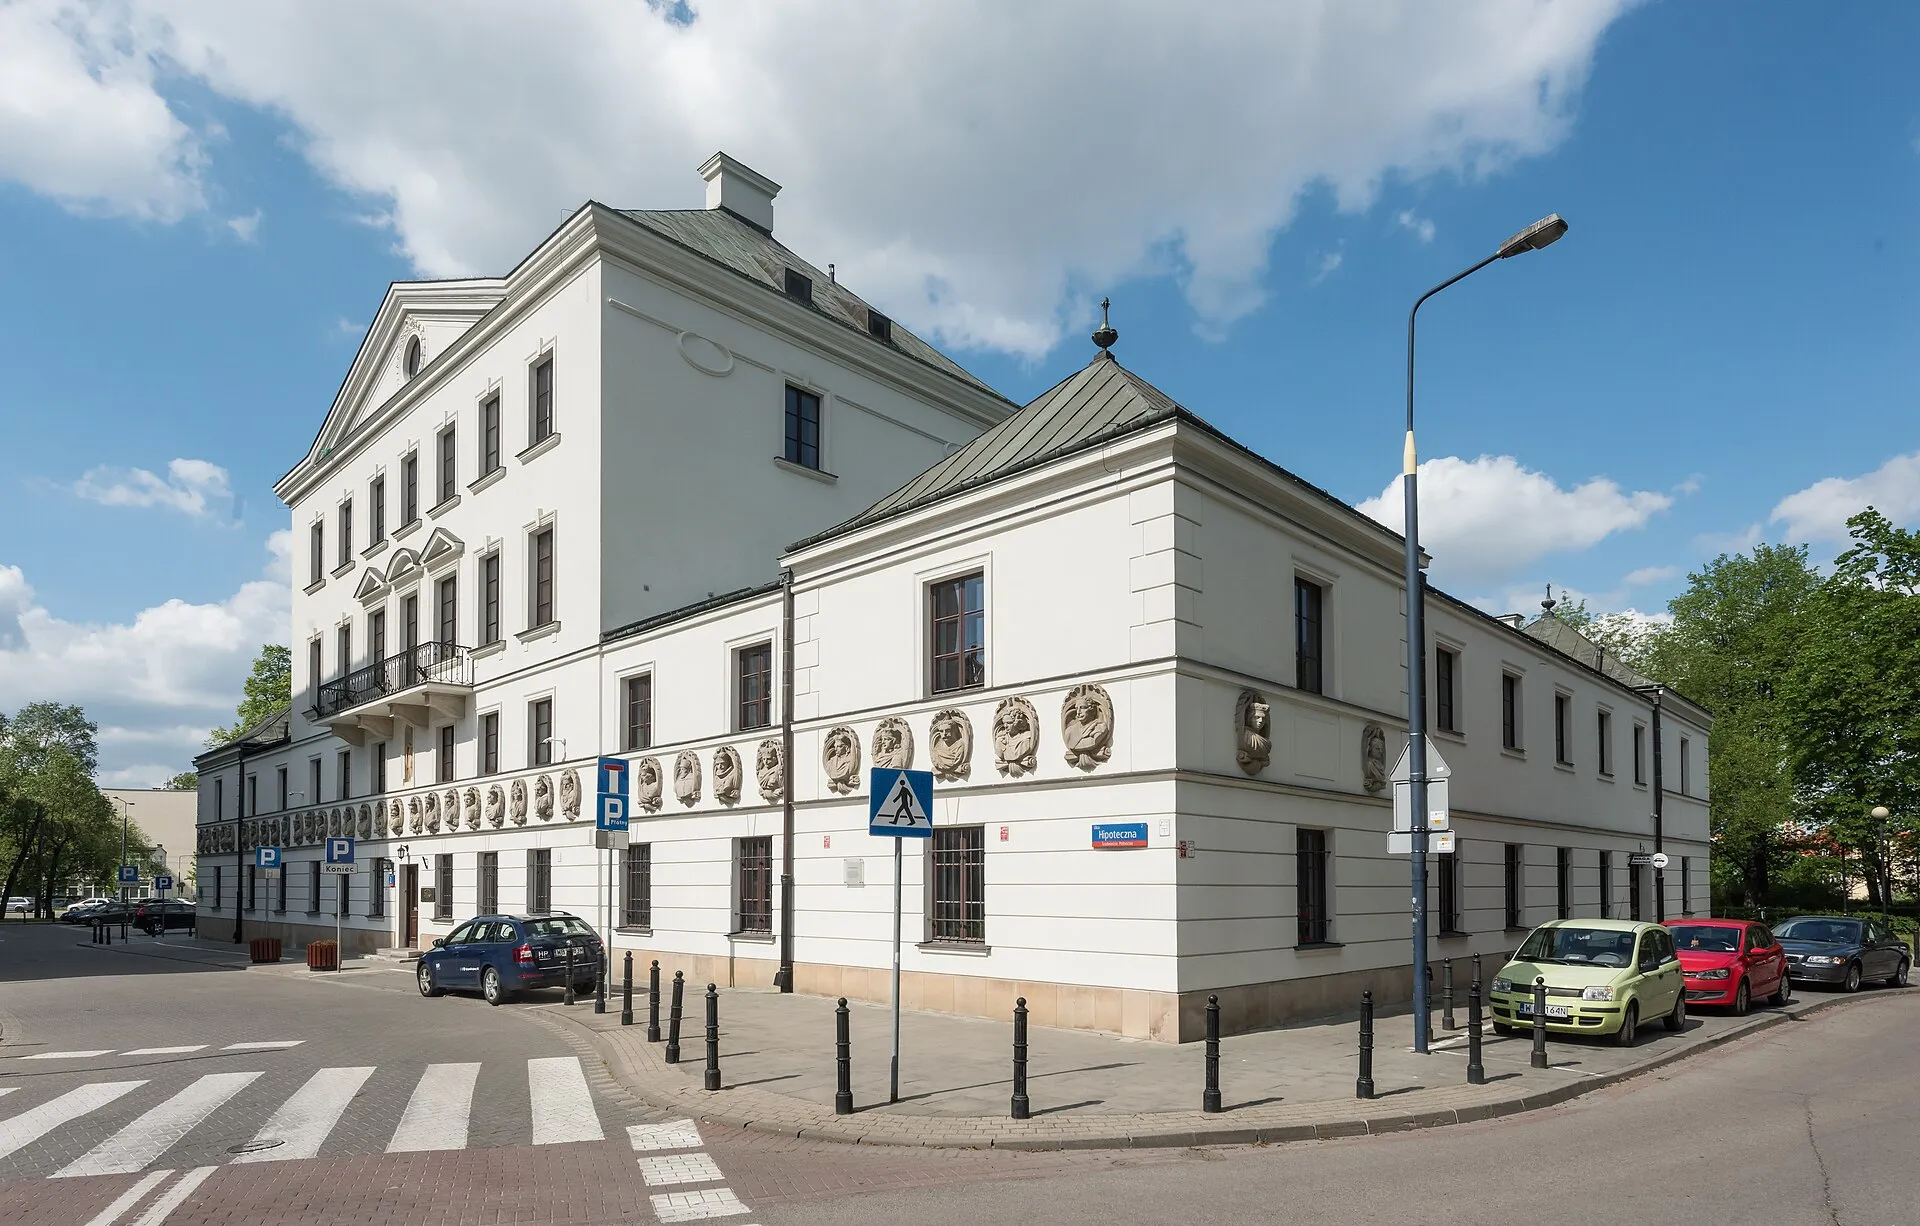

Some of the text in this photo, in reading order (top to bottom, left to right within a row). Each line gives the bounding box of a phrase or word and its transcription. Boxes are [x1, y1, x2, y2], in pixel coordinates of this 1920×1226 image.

[604, 797, 623, 826] P
[1098, 830, 1137, 841] Hipoteczna
[332, 840, 350, 860] P
[260, 848, 276, 866] P
[123, 867, 135, 880] P
[325, 865, 354, 873] Koniec
[159, 877, 169, 889] P
